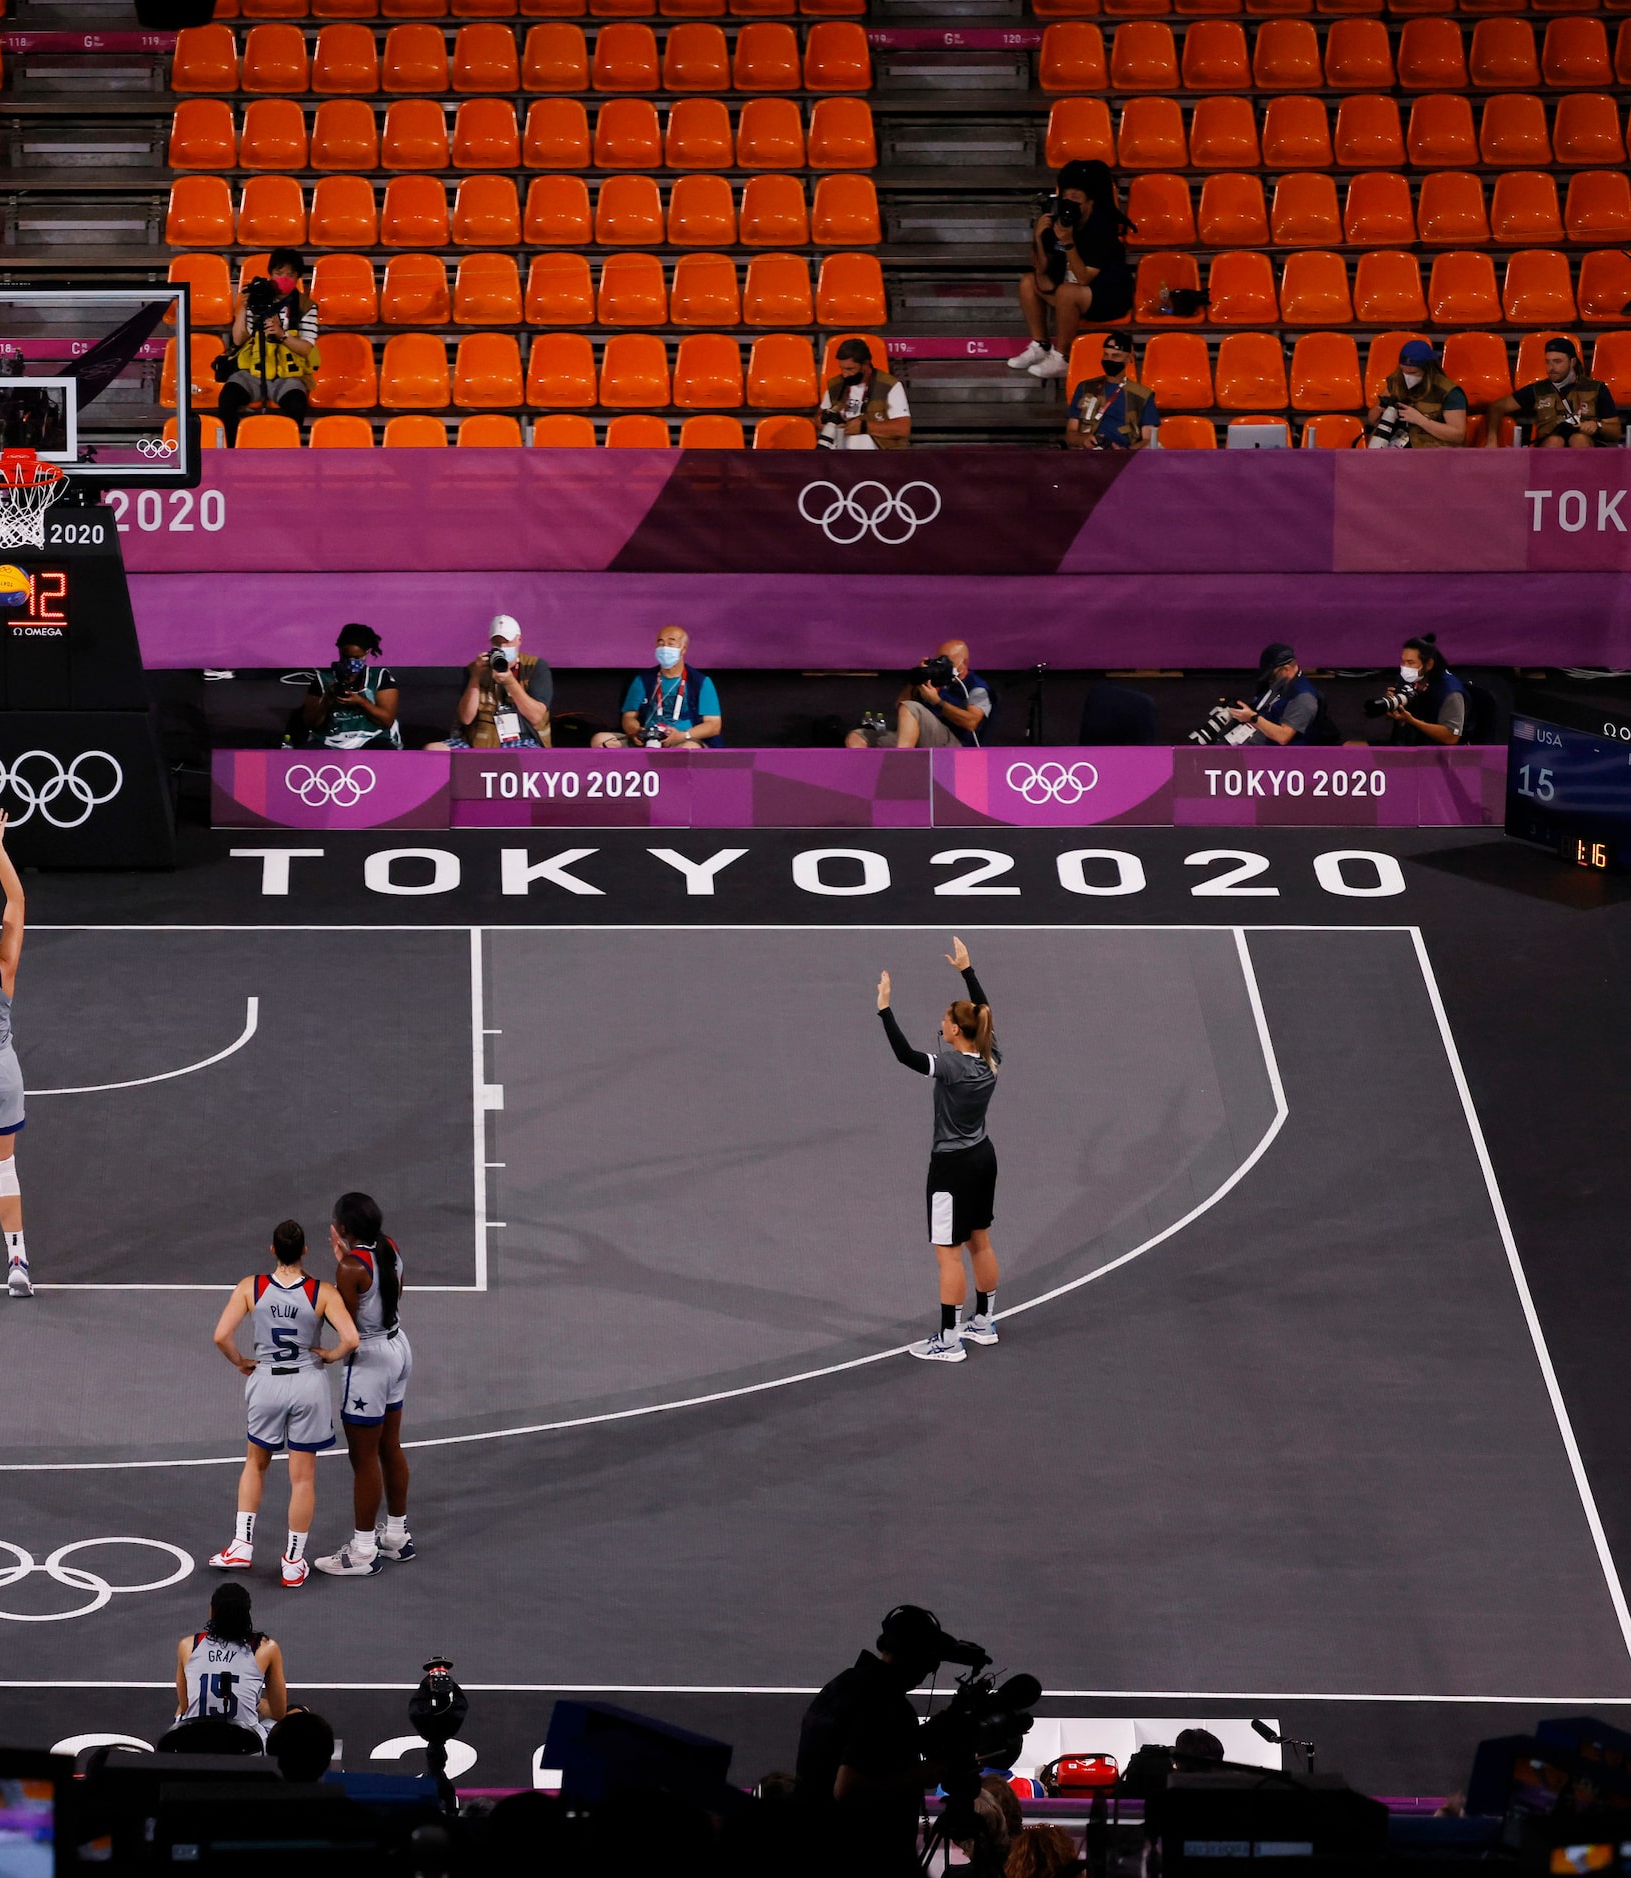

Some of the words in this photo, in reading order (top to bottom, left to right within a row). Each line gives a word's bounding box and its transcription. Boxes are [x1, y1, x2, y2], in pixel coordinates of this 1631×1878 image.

[9, 38, 26, 46] 118
[84, 36, 93, 47] G
[142, 36, 159, 45] 119
[944, 33, 953, 44] G
[1003, 34, 1021, 43] 120
[71, 342, 81, 354] C
[888, 342, 907, 352] 119
[967, 342, 976, 354] C
[105, 490, 225, 531] 2020
[50, 523, 104, 544] 2020
[30, 573, 66, 618] 12
[25, 628, 63, 636] OMEGA
[1537, 729, 1563, 748] USA
[480, 771, 580, 798] TOKYO
[587, 771, 660, 797] 2020
[1204, 770, 1305, 796] TOKYO
[1312, 769, 1386, 796] 2020
[1518, 764, 1555, 801] 15
[1577, 840, 1607, 868] 1:16
[271, 1304, 299, 1320] PLUM
[271, 1328, 299, 1362] 5
[209, 1650, 237, 1663] GRAY
[199, 1673, 240, 1719] 15
